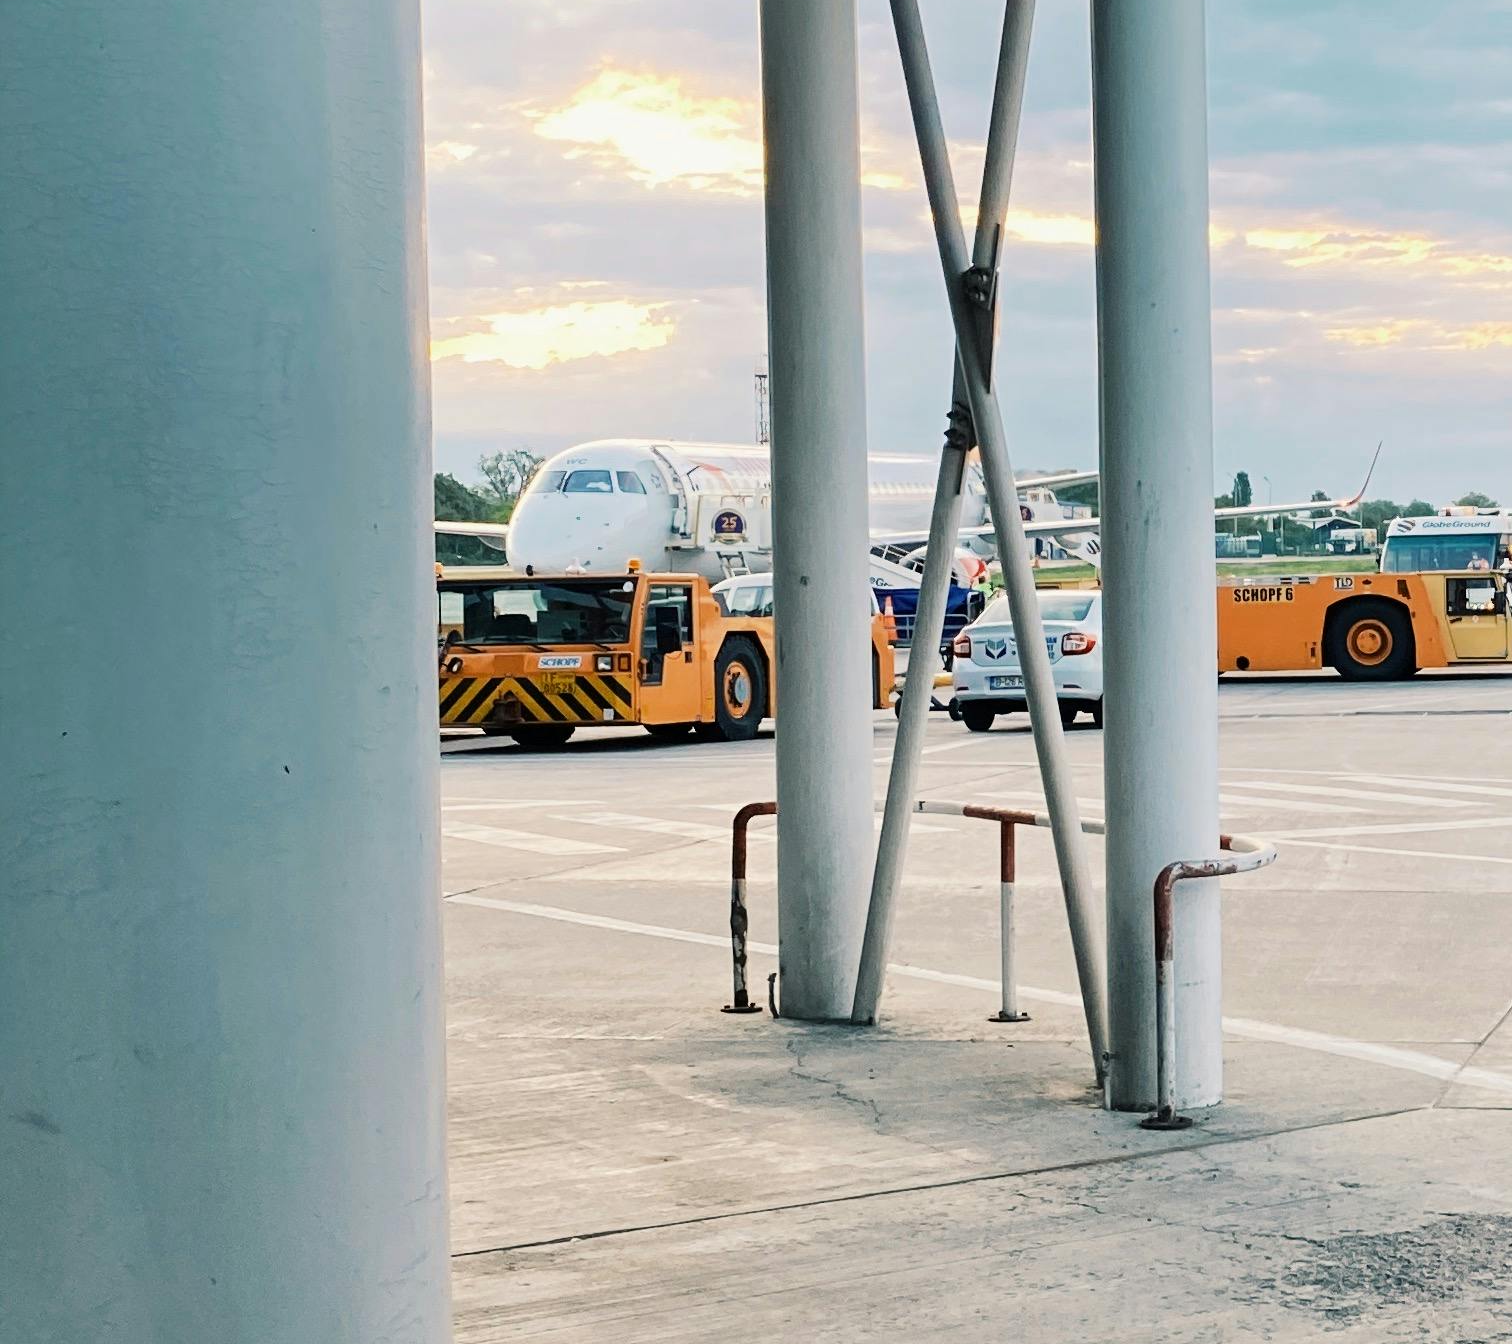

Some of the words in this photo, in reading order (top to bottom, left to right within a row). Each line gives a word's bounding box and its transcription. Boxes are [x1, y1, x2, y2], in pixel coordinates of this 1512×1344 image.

[721, 516, 738, 529] 25
[1421, 520, 1491, 529] GlobeGround
[1335, 577, 1353, 587] TLD
[1233, 587, 1282, 602] SCHOPF
[1285, 587, 1294, 601] 6
[540, 657, 579, 667] SCHOPF
